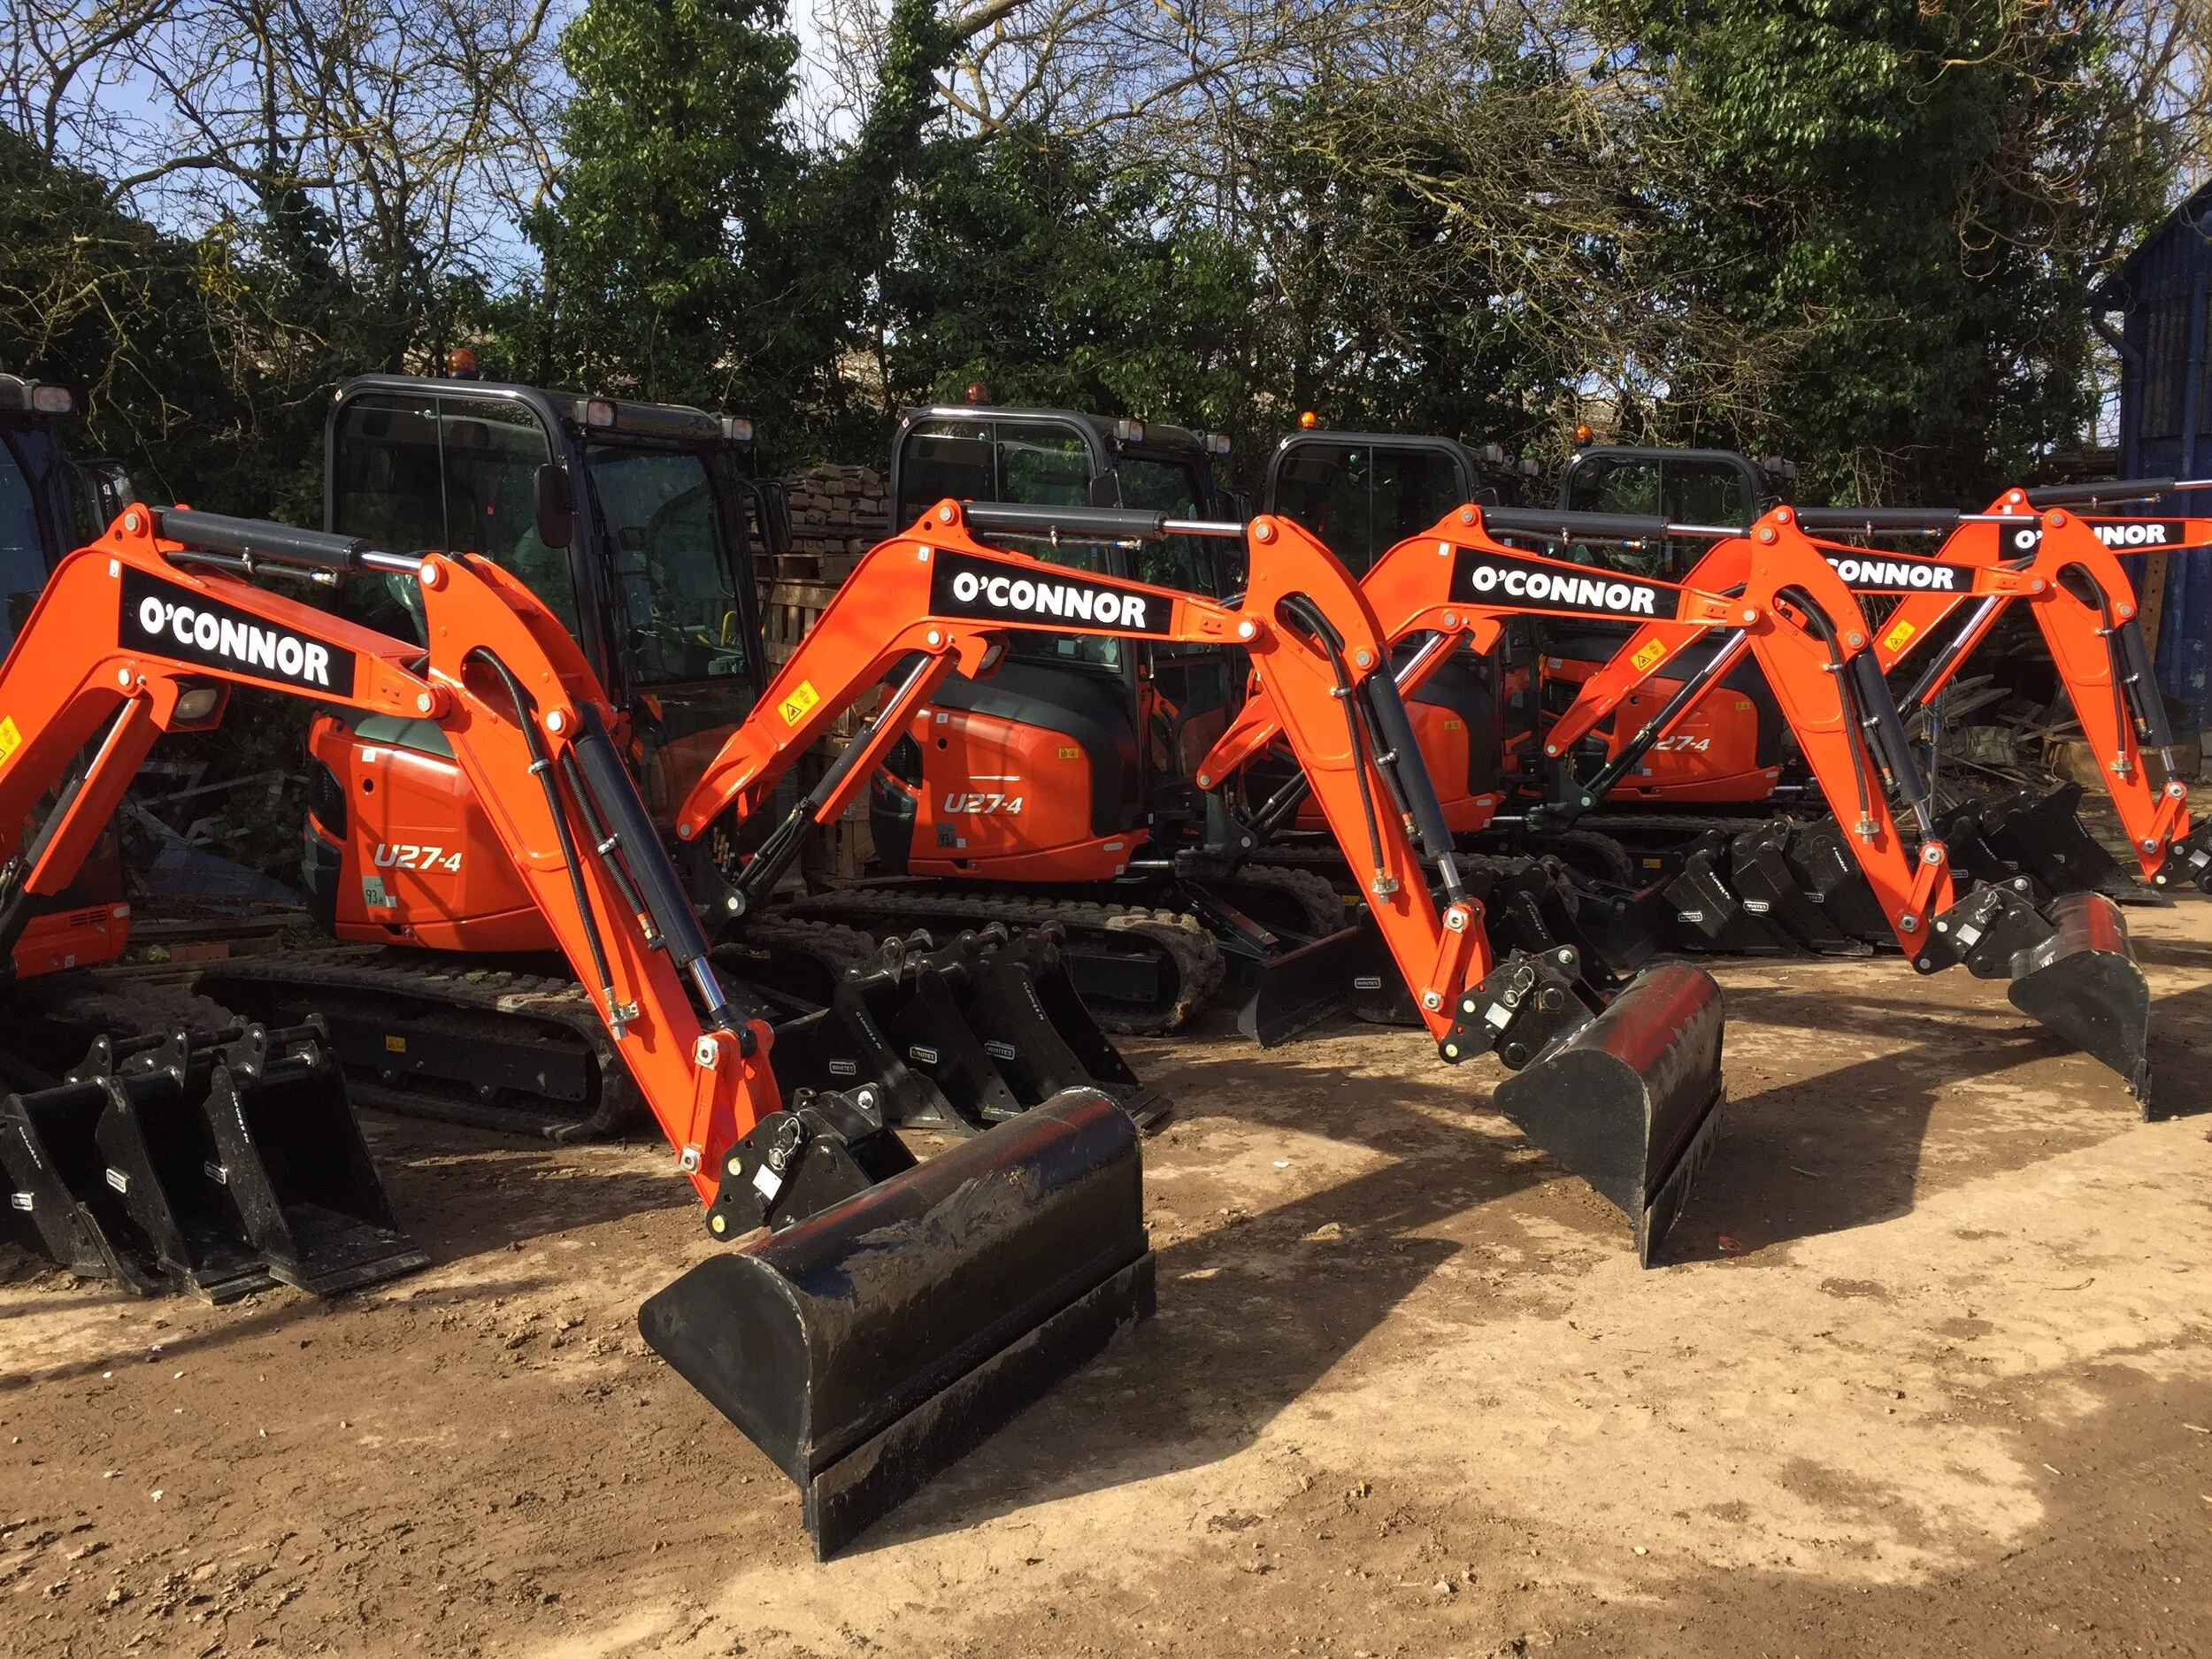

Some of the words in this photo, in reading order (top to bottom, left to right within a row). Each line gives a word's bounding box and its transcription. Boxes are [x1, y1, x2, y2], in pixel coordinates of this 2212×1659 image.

[2015, 524, 2167, 549] O'NOR
[953, 572, 1146, 628] O'CONNOR
[1471, 565, 1655, 614] O'CONNOR
[139, 596, 329, 686] O'CONNOR
[1648, 735, 1711, 751] 27-4
[944, 793, 1023, 814] U27-4
[374, 843, 463, 872] U27-4
[365, 889, 379, 904] 93
[1356, 979, 1379, 987] WHITES
[986, 1045, 1014, 1058] WHITES
[832, 1064, 855, 1073] WHITES
